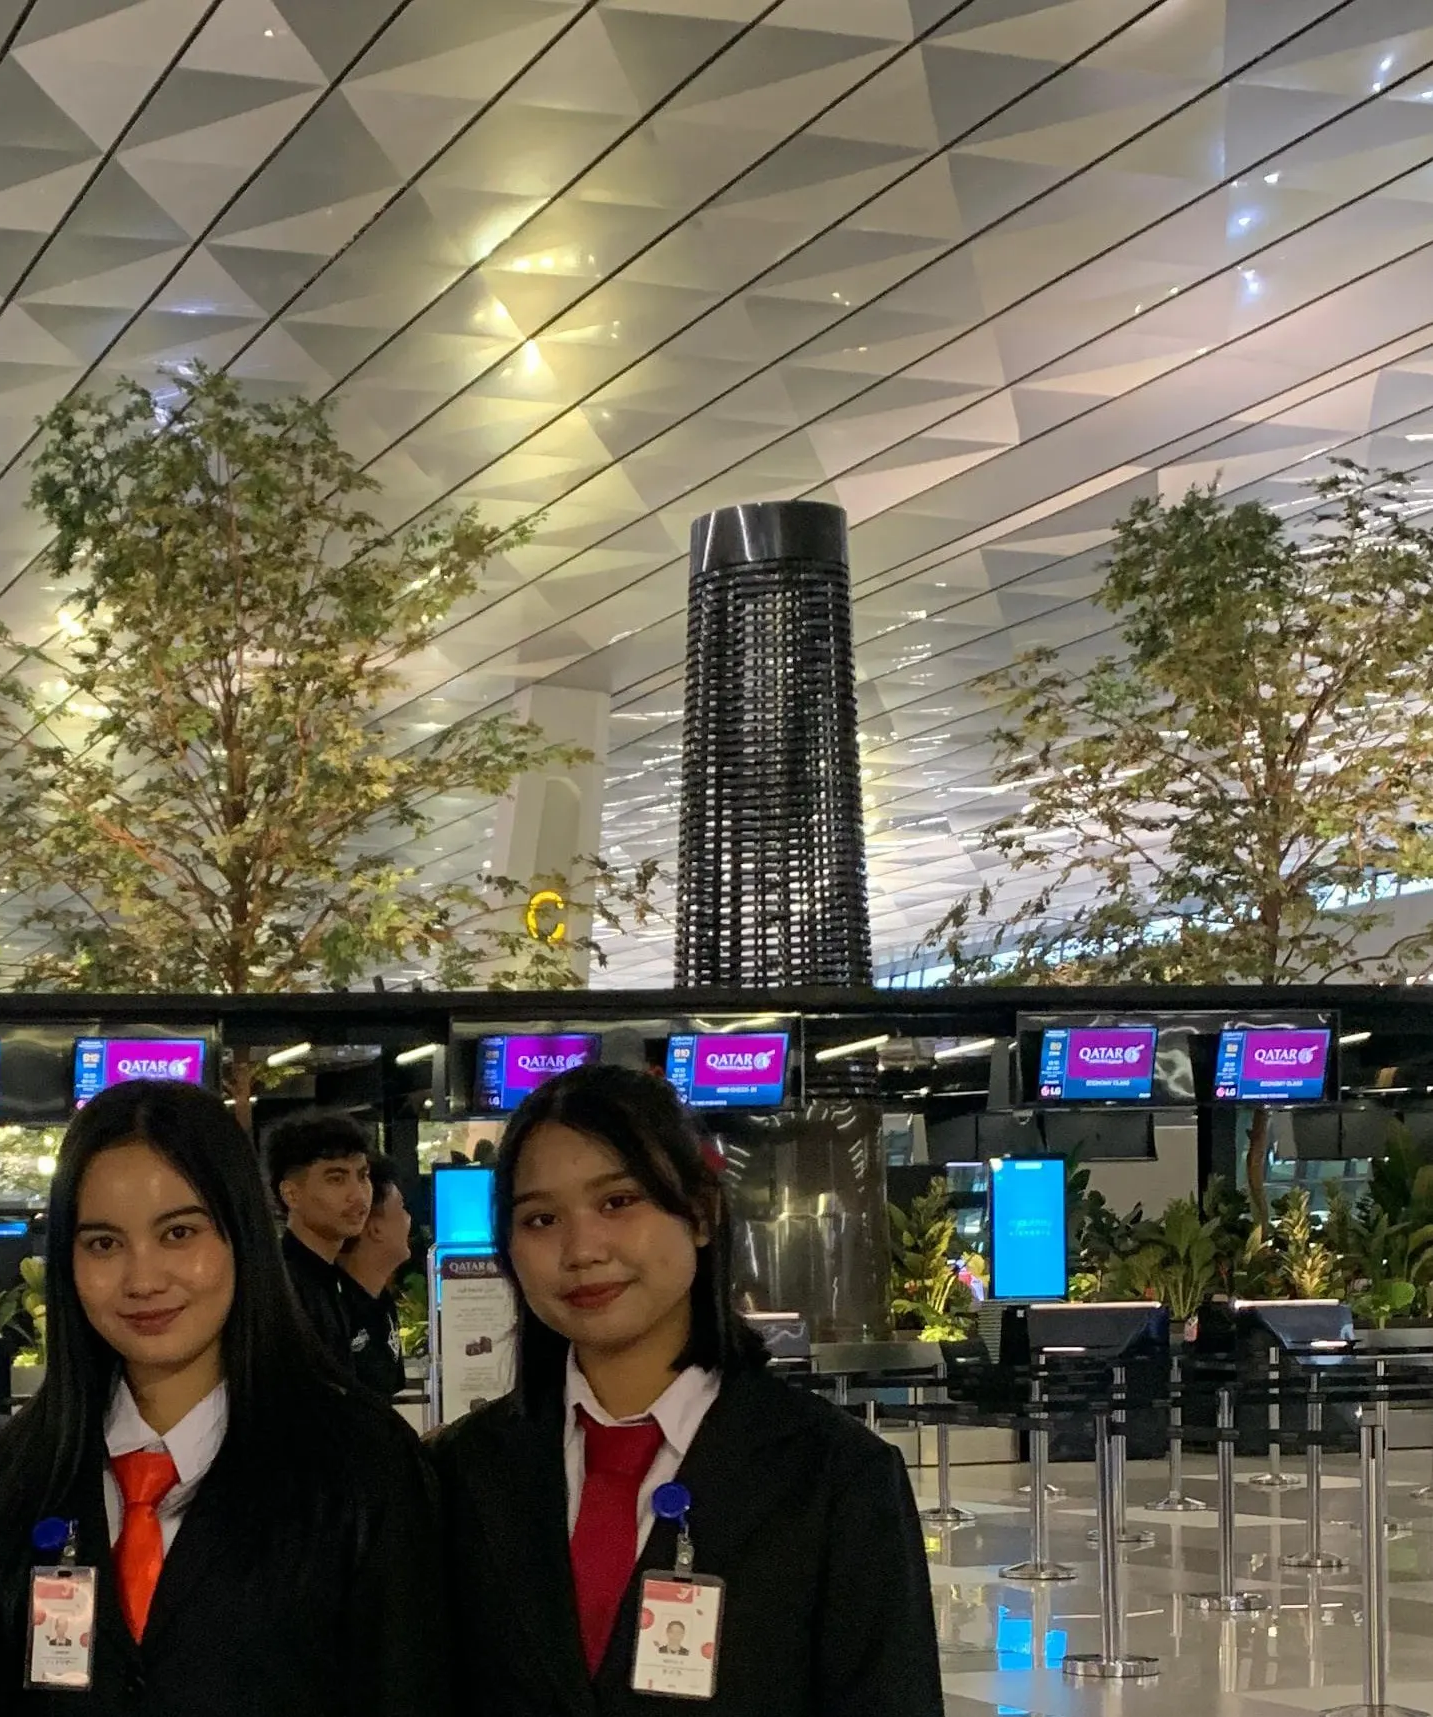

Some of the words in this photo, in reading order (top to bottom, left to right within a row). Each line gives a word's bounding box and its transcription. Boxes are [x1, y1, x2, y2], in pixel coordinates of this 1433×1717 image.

[527, 891, 565, 943] C
[706, 1053, 754, 1067] QATAR
[1079, 1047, 1123, 1061] QATAR
[1254, 1048, 1298, 1062] QATAR
[117, 1059, 168, 1075] QATAR
[517, 1055, 565, 1068] QATAR
[449, 1261, 486, 1272] QATAR
